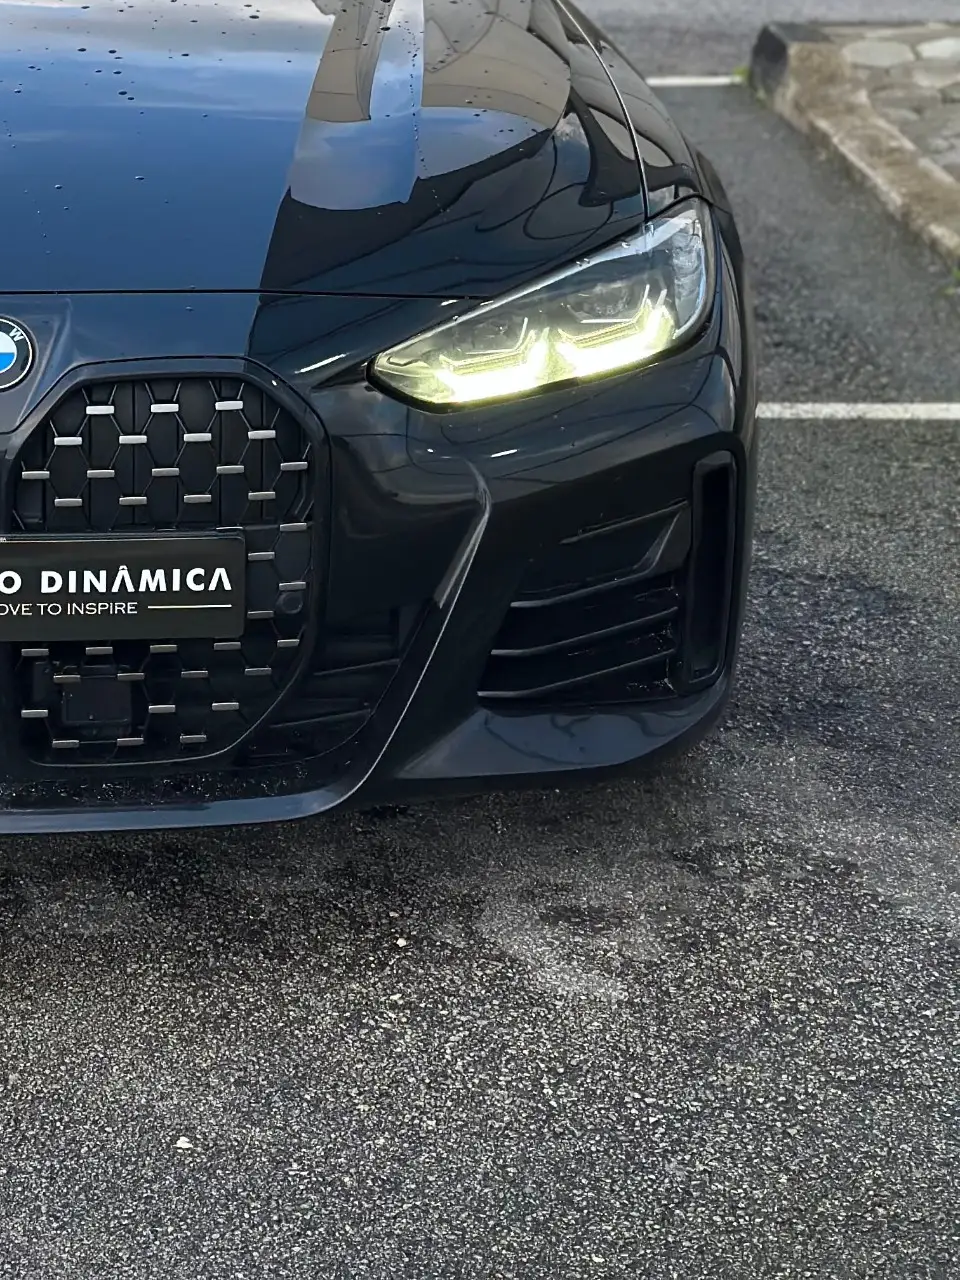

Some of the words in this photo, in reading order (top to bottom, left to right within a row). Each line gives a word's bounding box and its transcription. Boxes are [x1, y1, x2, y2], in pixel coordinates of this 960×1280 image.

[40, 565, 232, 594] DINÂMICA
[36, 602, 62, 616] TO
[66, 601, 138, 616] INSPIRE
